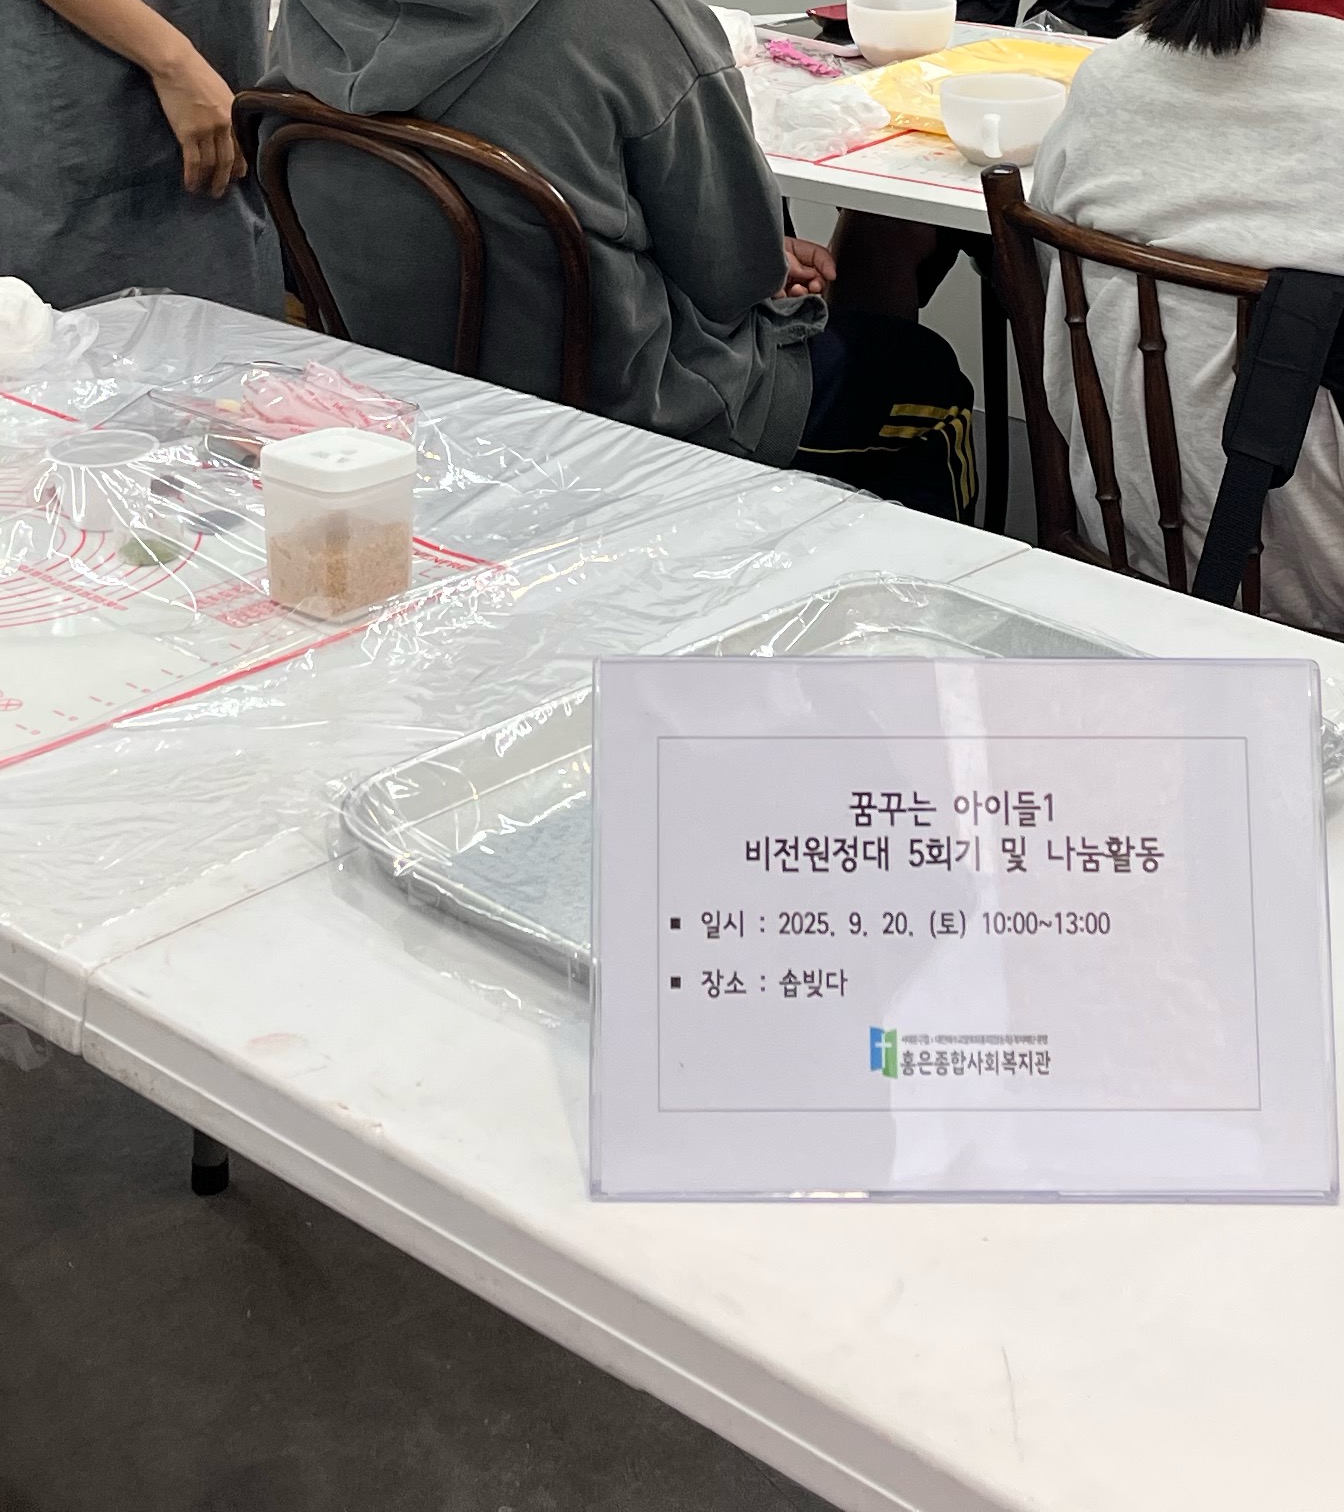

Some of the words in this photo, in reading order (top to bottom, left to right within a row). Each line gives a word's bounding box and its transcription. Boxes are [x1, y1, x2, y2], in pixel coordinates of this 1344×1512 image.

[849, 790, 937, 828] 꿈꾸는
[953, 789, 1054, 828] 아이들1
[745, 835, 890, 874] 비전원정대
[908, 835, 981, 873] 5회기
[1001, 835, 1028, 873] 및
[1047, 835, 1165, 874] 나눔활동
[700, 909, 744, 940] 일시
[778, 911, 835, 938] 2025.
[848, 911, 868, 938] 9.
[882, 911, 914, 938] 20.
[929, 909, 966, 939] (토)
[982, 911, 1111, 936] 10:00~13:00
[701, 968, 747, 999] 장소
[778, 968, 849, 999] 솝빚다
[900, 1049, 1052, 1078] 홍은종합사회복지관
